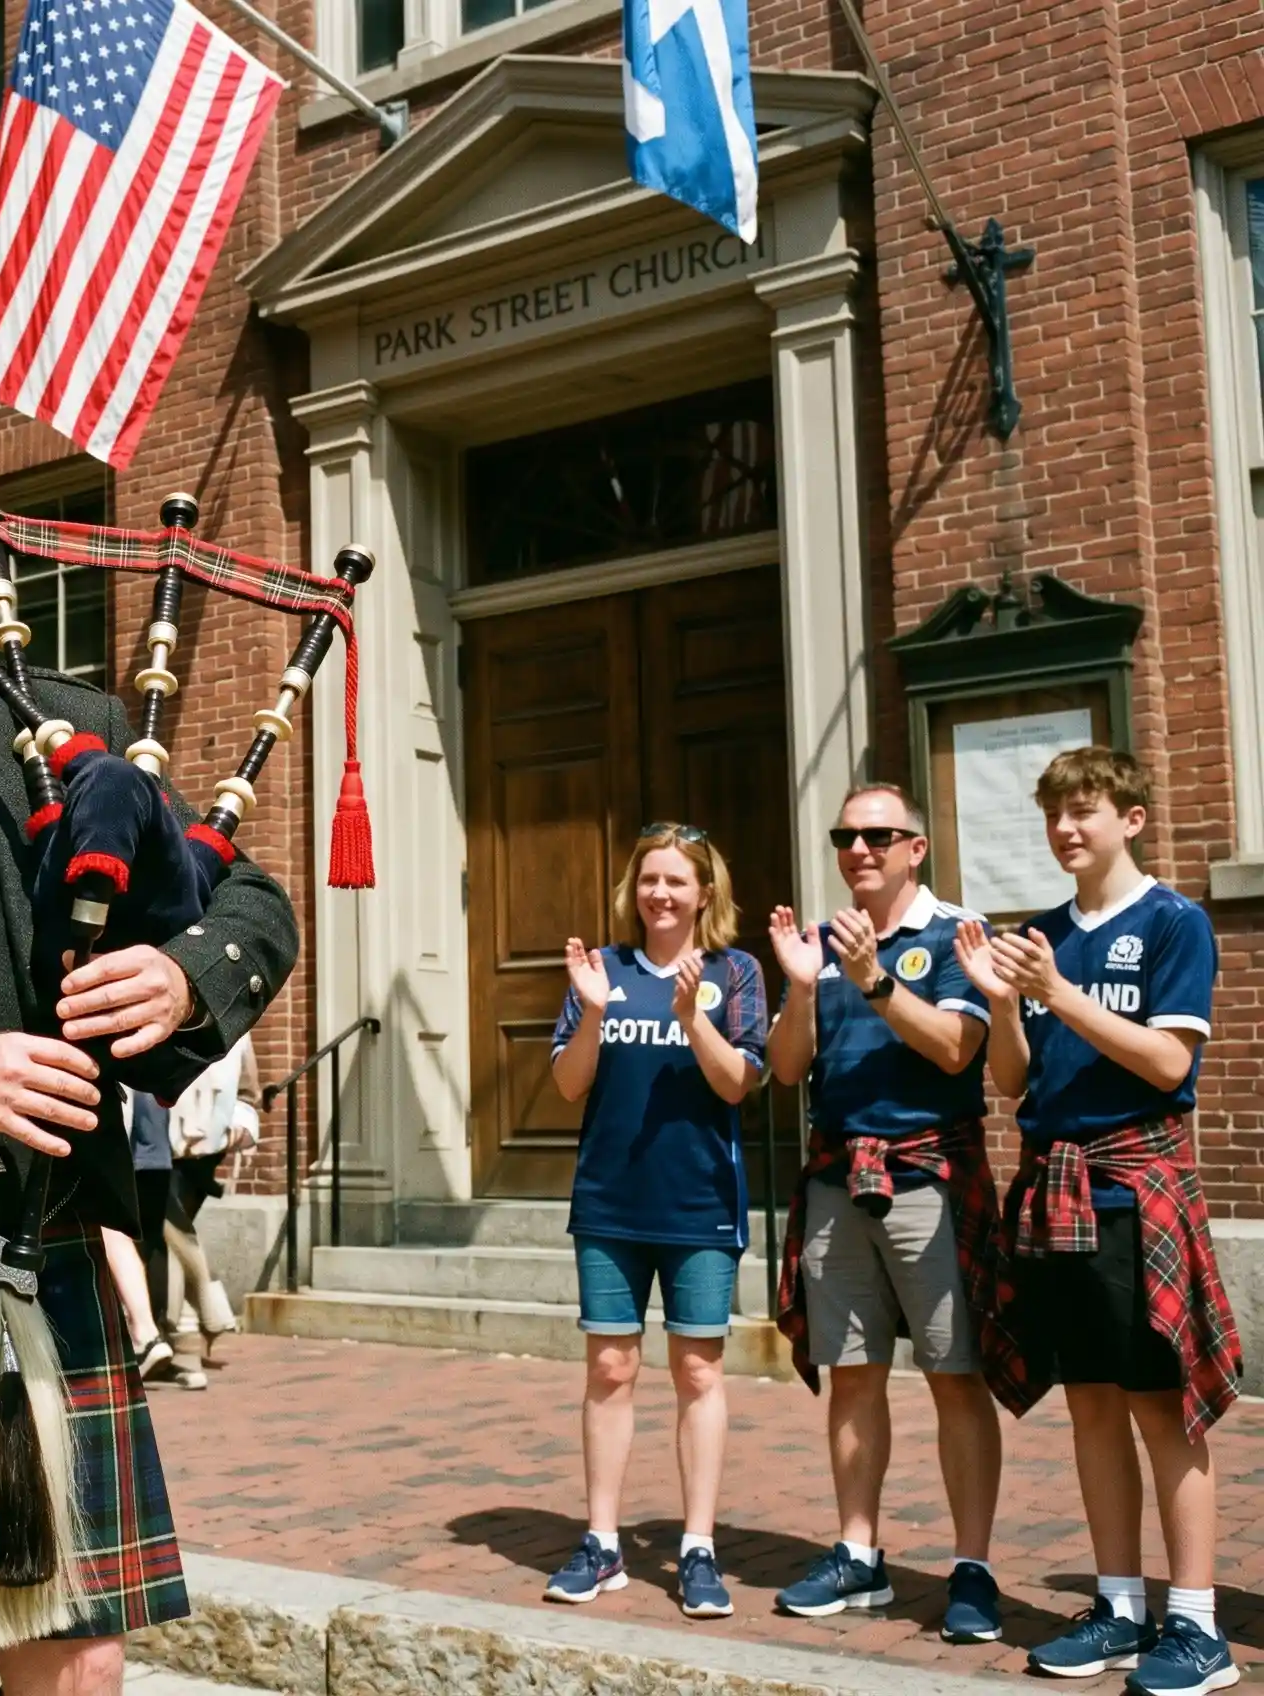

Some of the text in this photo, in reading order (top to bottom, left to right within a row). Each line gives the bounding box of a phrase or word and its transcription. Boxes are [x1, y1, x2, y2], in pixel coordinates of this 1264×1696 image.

[374, 222, 765, 366] PARK STREET CHURCH
